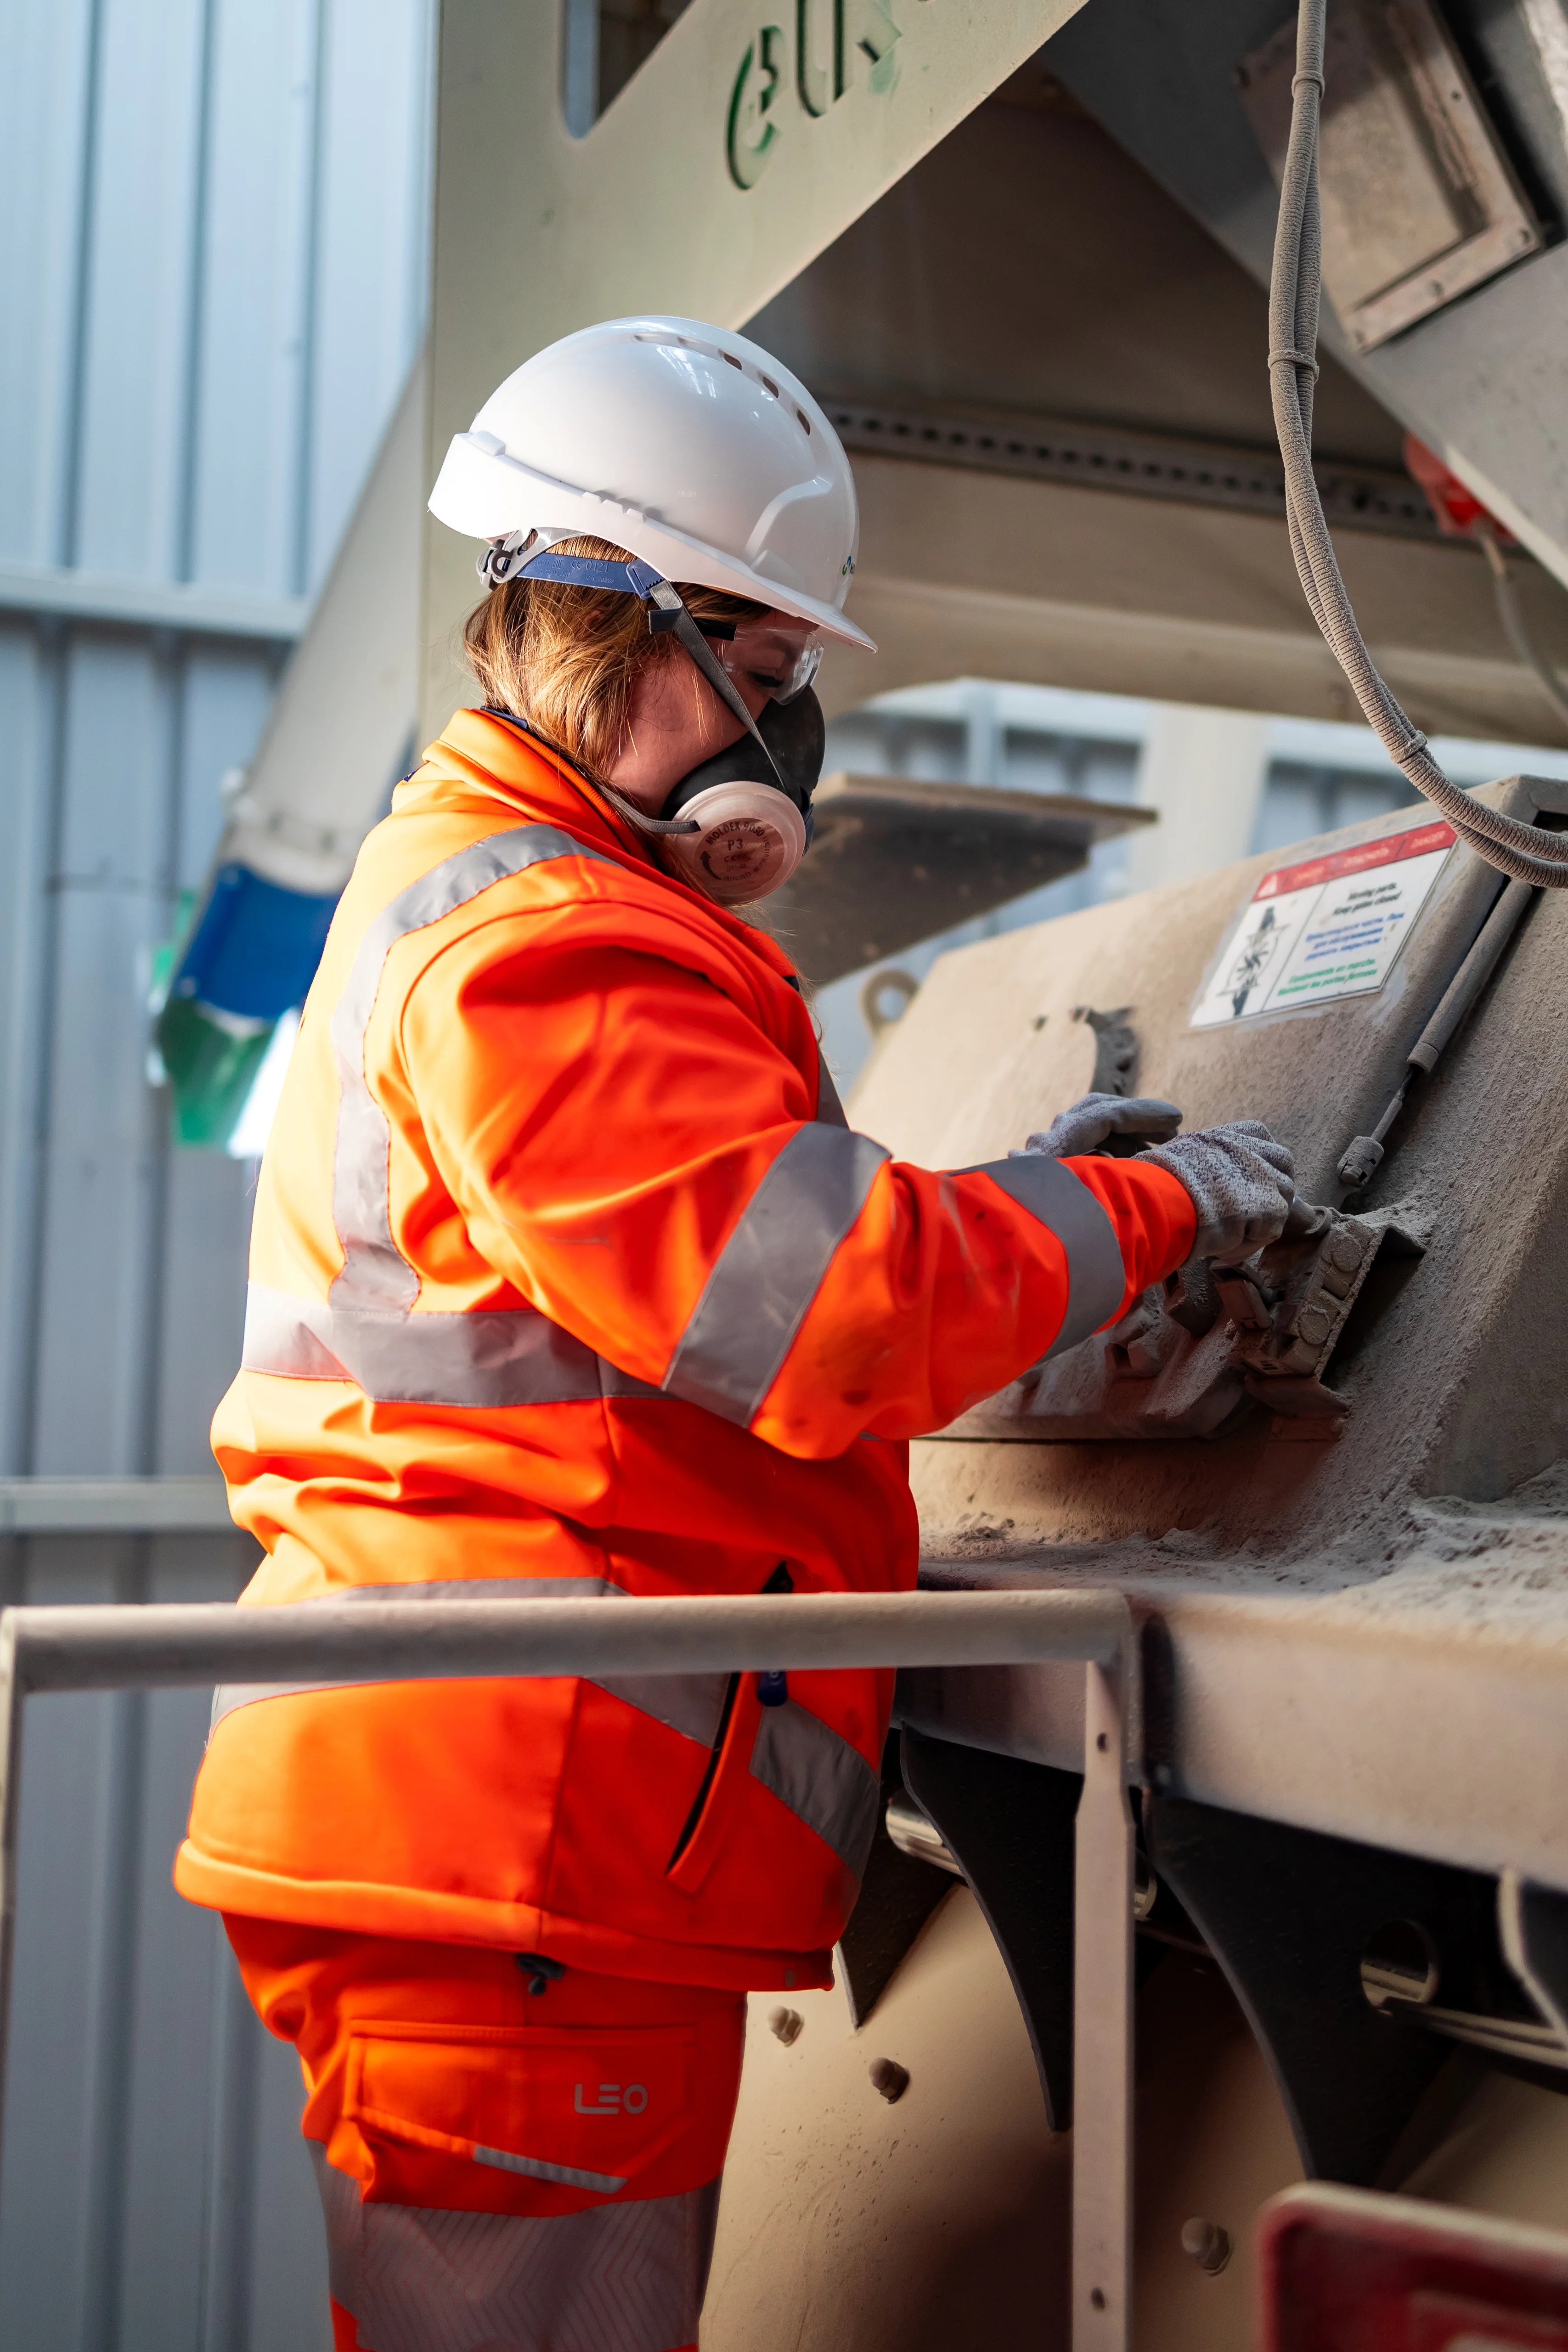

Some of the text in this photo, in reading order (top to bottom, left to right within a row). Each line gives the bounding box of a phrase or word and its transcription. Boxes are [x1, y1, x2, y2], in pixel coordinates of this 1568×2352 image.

[586, 560, 609, 573] 0121
[705, 821, 741, 845] MOLDEX
[574, 2083, 648, 2114] LEO
